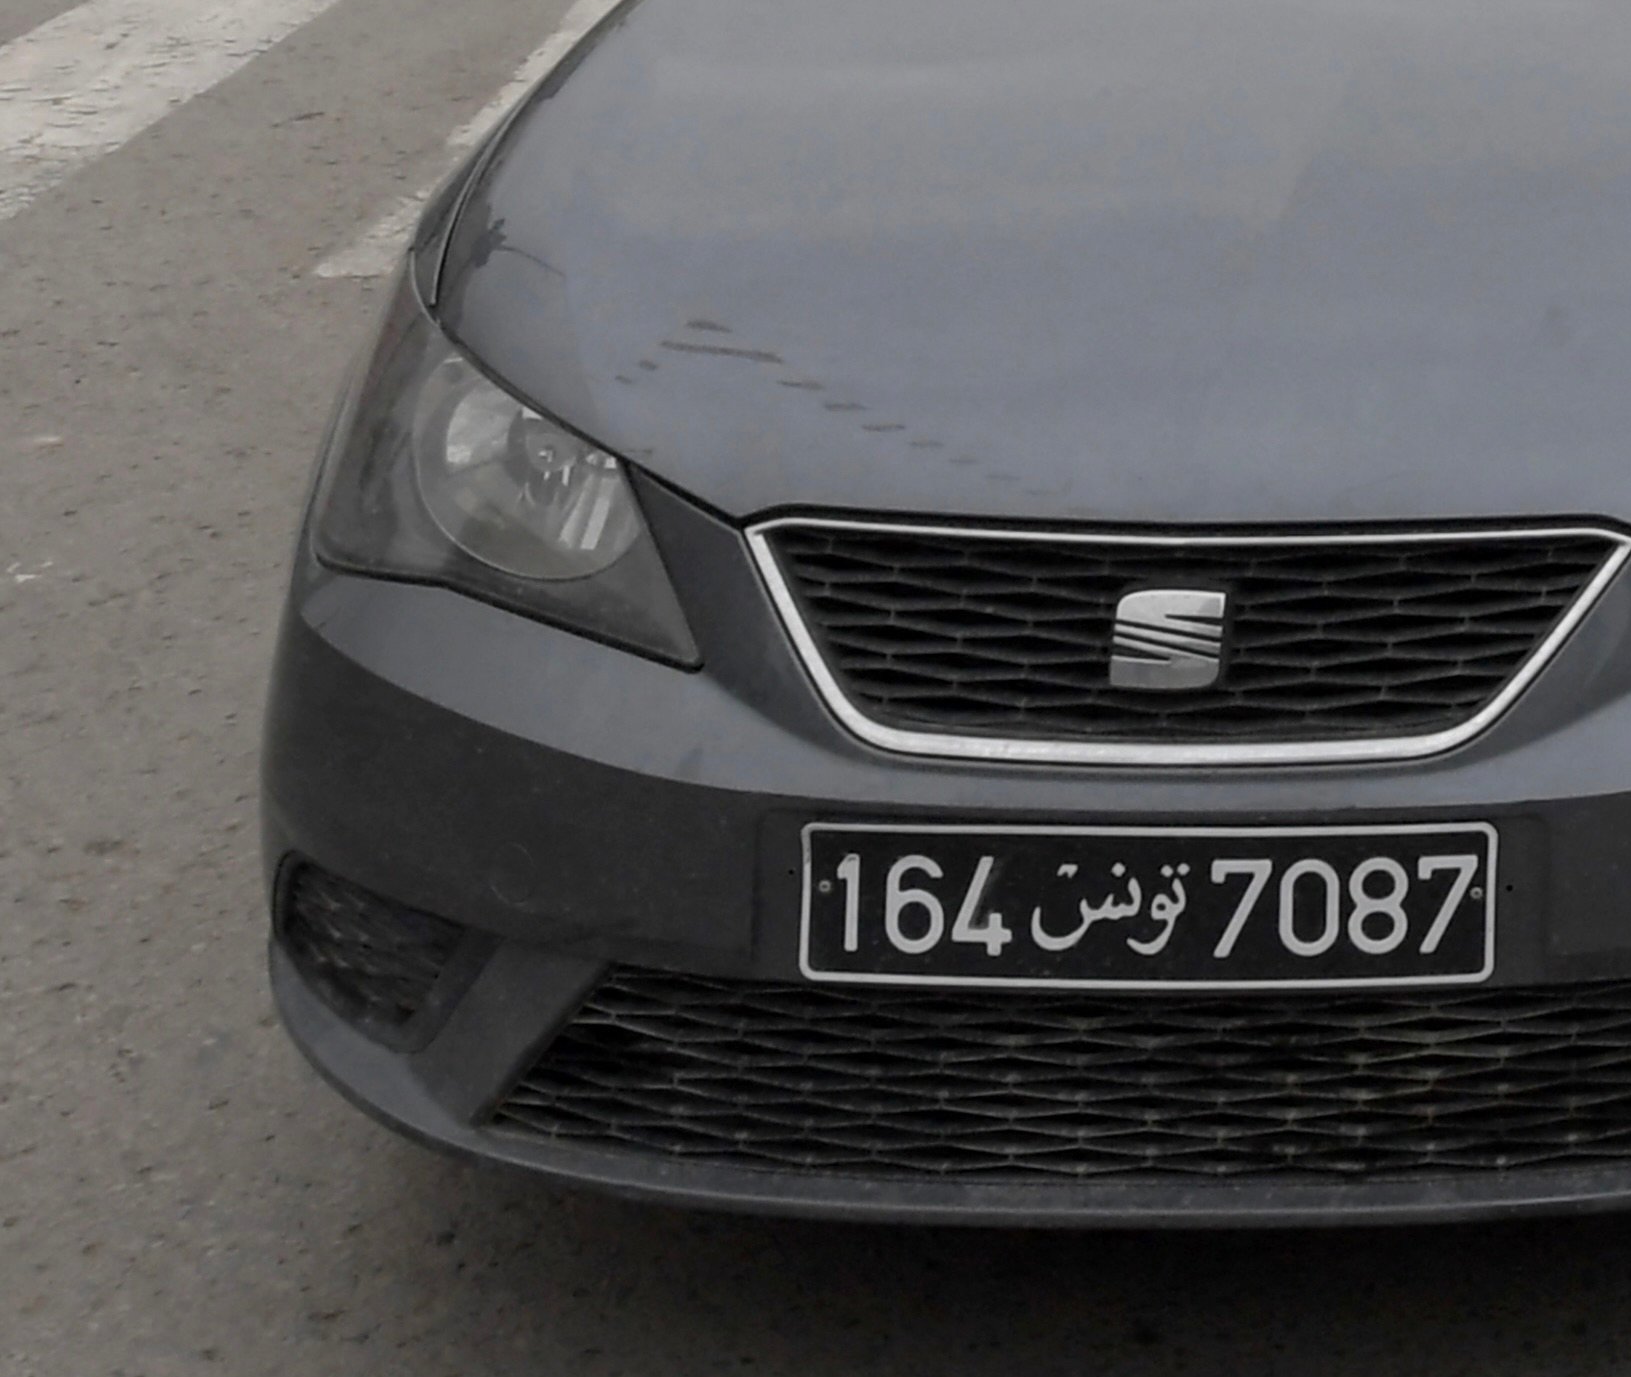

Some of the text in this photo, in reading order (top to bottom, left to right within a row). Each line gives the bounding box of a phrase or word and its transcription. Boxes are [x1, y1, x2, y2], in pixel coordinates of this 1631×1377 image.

[836, 852, 1480, 959] 164 تونس 7087
